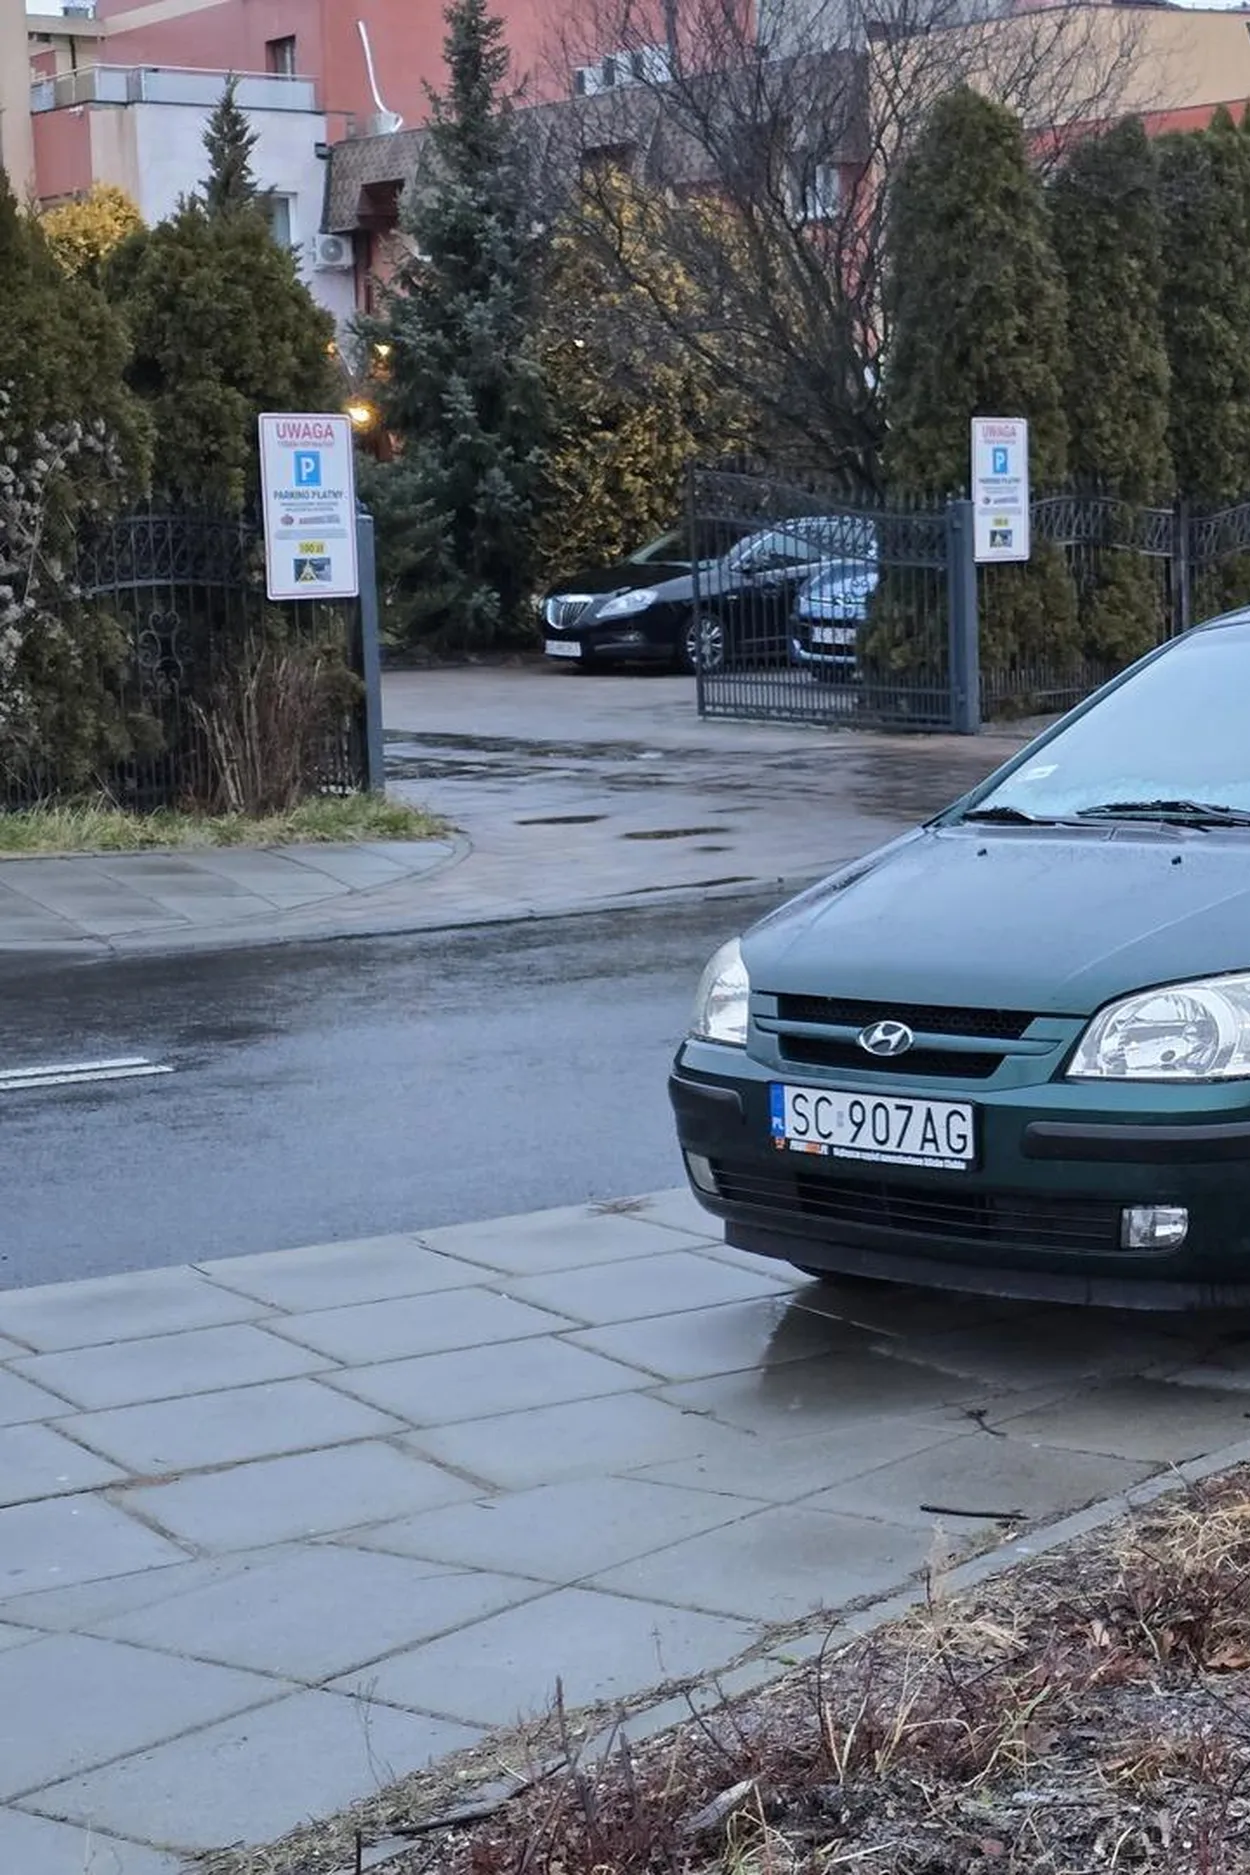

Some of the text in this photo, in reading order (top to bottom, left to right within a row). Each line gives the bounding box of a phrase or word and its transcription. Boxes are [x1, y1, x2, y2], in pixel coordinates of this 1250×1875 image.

[276, 422, 334, 439] UWAGA
[301, 456, 315, 481] P
[996, 451, 1006, 471] P
[792, 1093, 967, 1154] SC 907AG
